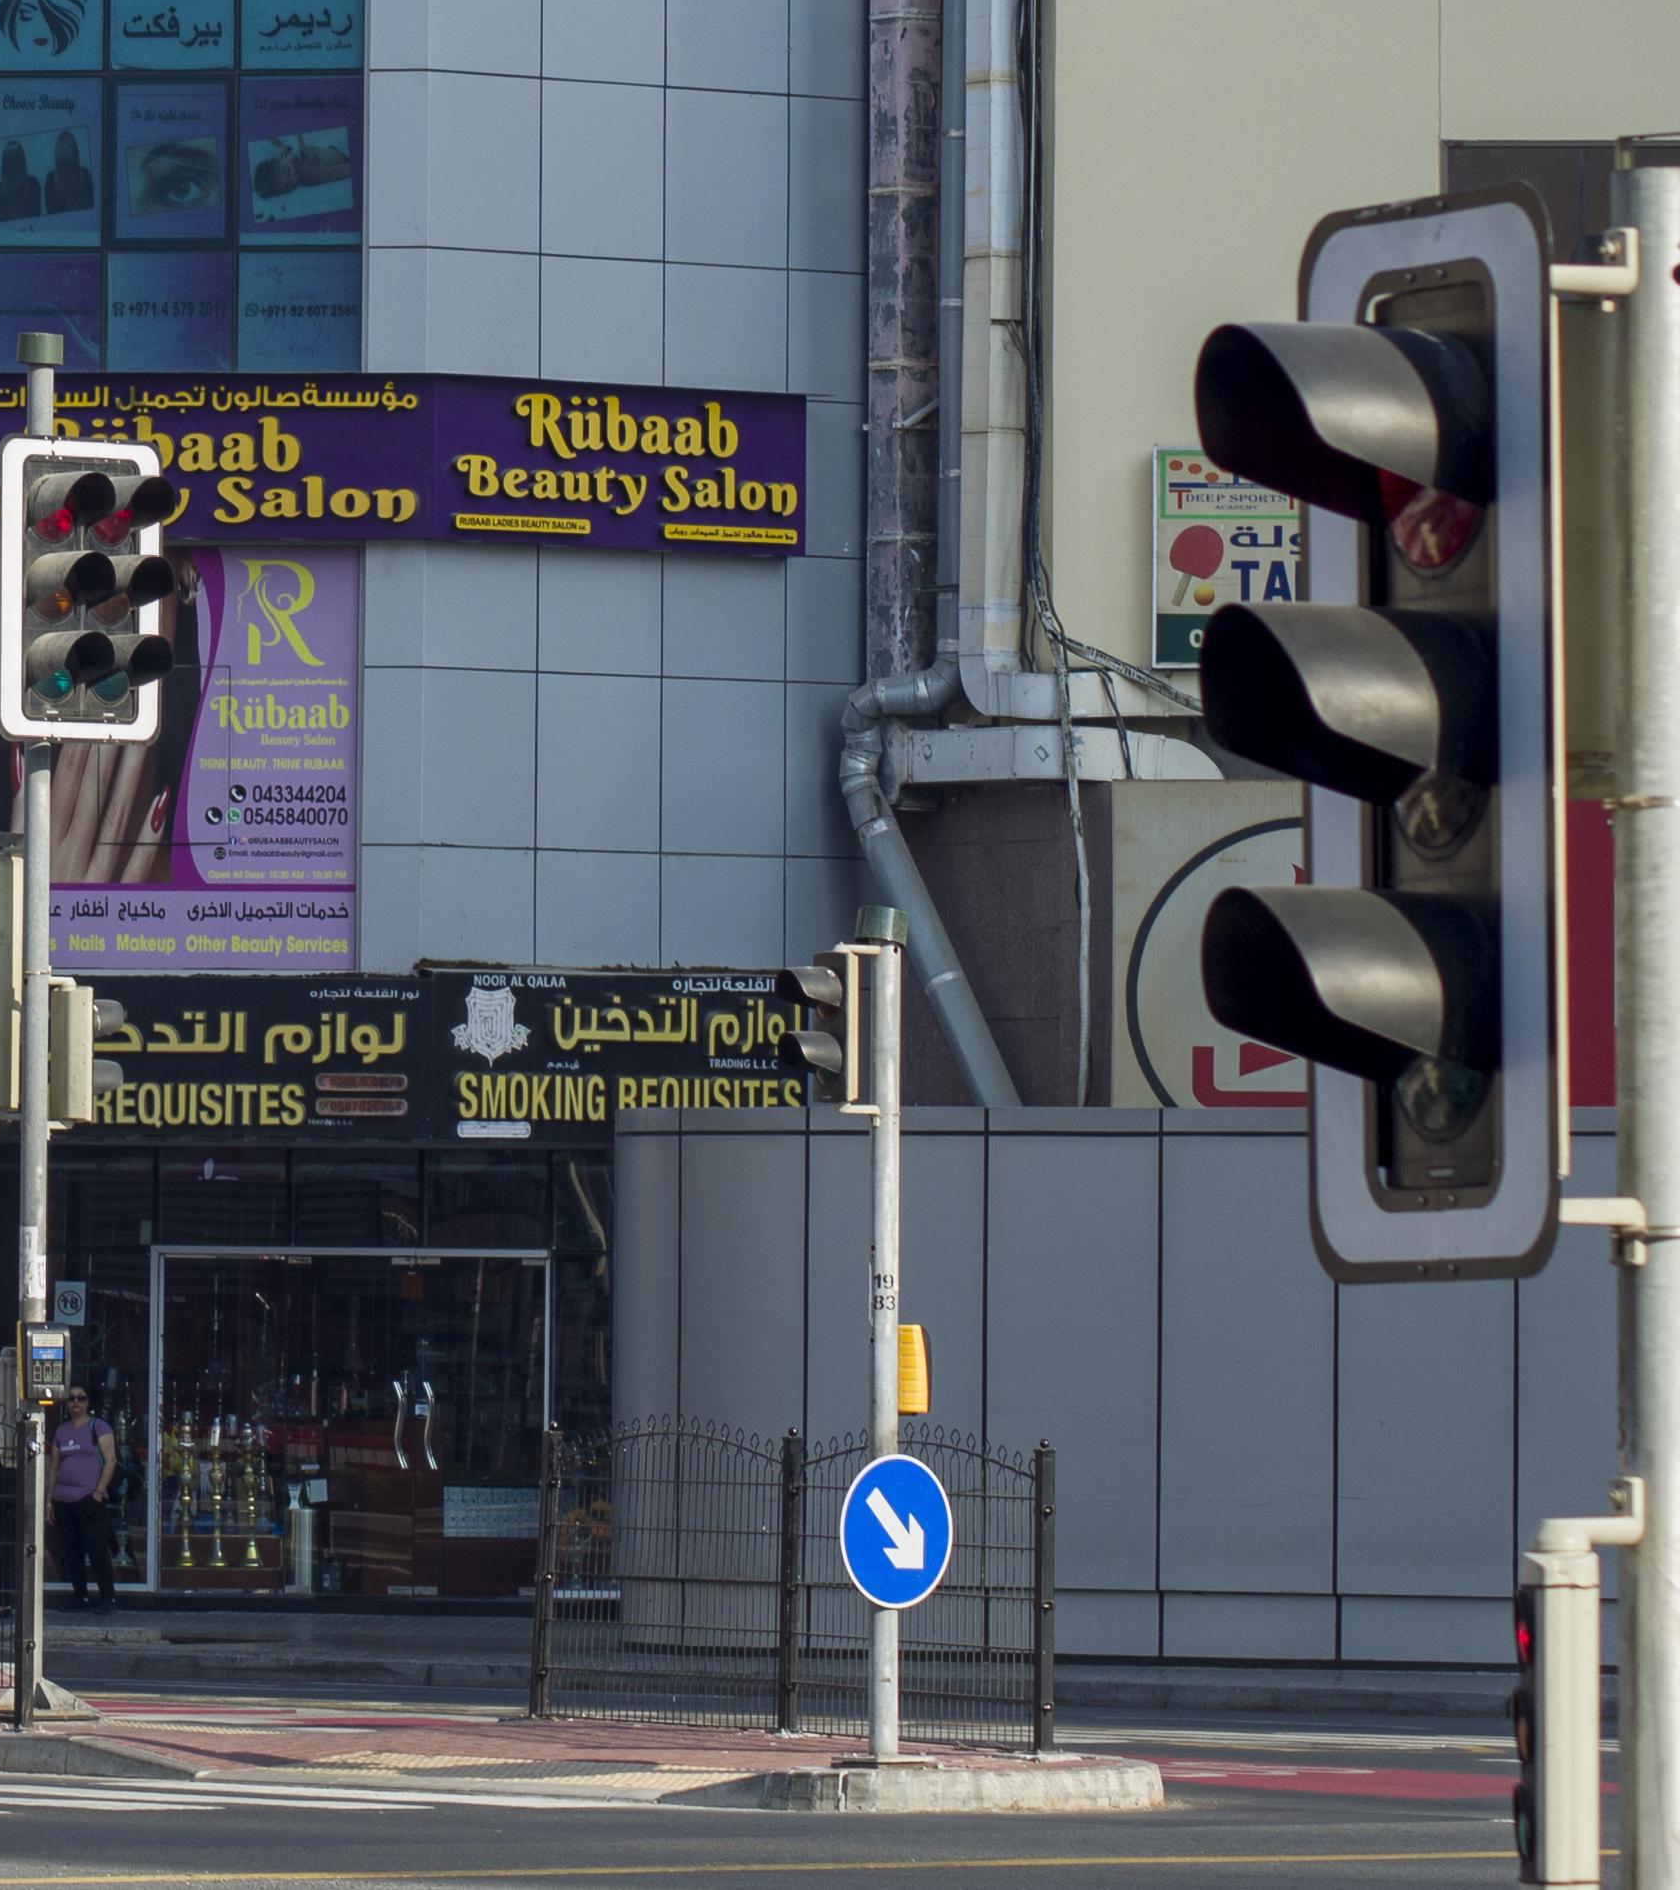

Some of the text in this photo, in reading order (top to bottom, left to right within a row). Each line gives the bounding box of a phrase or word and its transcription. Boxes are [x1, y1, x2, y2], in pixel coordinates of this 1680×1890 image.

[515, 393, 738, 460] Rübaab
[456, 454, 798, 517] Beauty Salon
[214, 475, 418, 524] Salon
[1186, 493, 1287, 503] DEEP SPORTS
[459, 517, 490, 527] RUBAAB
[492, 518, 519, 528] LADIES
[521, 519, 550, 529] BEAUTY
[552, 520, 577, 530] SALON
[210, 694, 350, 734] Rübaab
[260, 734, 336, 747] Beauty Salon
[252, 785, 347, 803] 043344204
[243, 807, 349, 826] 0545840070
[235, 901, 293, 921] التجميل
[296, 902, 349, 920] خدمات
[69, 935, 105, 952] Nails
[116, 934, 177, 956] Makeup
[185, 934, 228, 953] Other
[231, 934, 282, 957] Beauty
[287, 934, 349, 954] Services
[473, 974, 567, 989] NOOR AL QALAA
[554, 996, 698, 1052] التدخين
[264, 1011, 407, 1064] لوازم
[709, 1058, 751, 1069] TRADING
[458, 1072, 607, 1122] SMOKING
[873, 1273, 895, 1289] 19
[873, 1295, 896, 1311] 83
